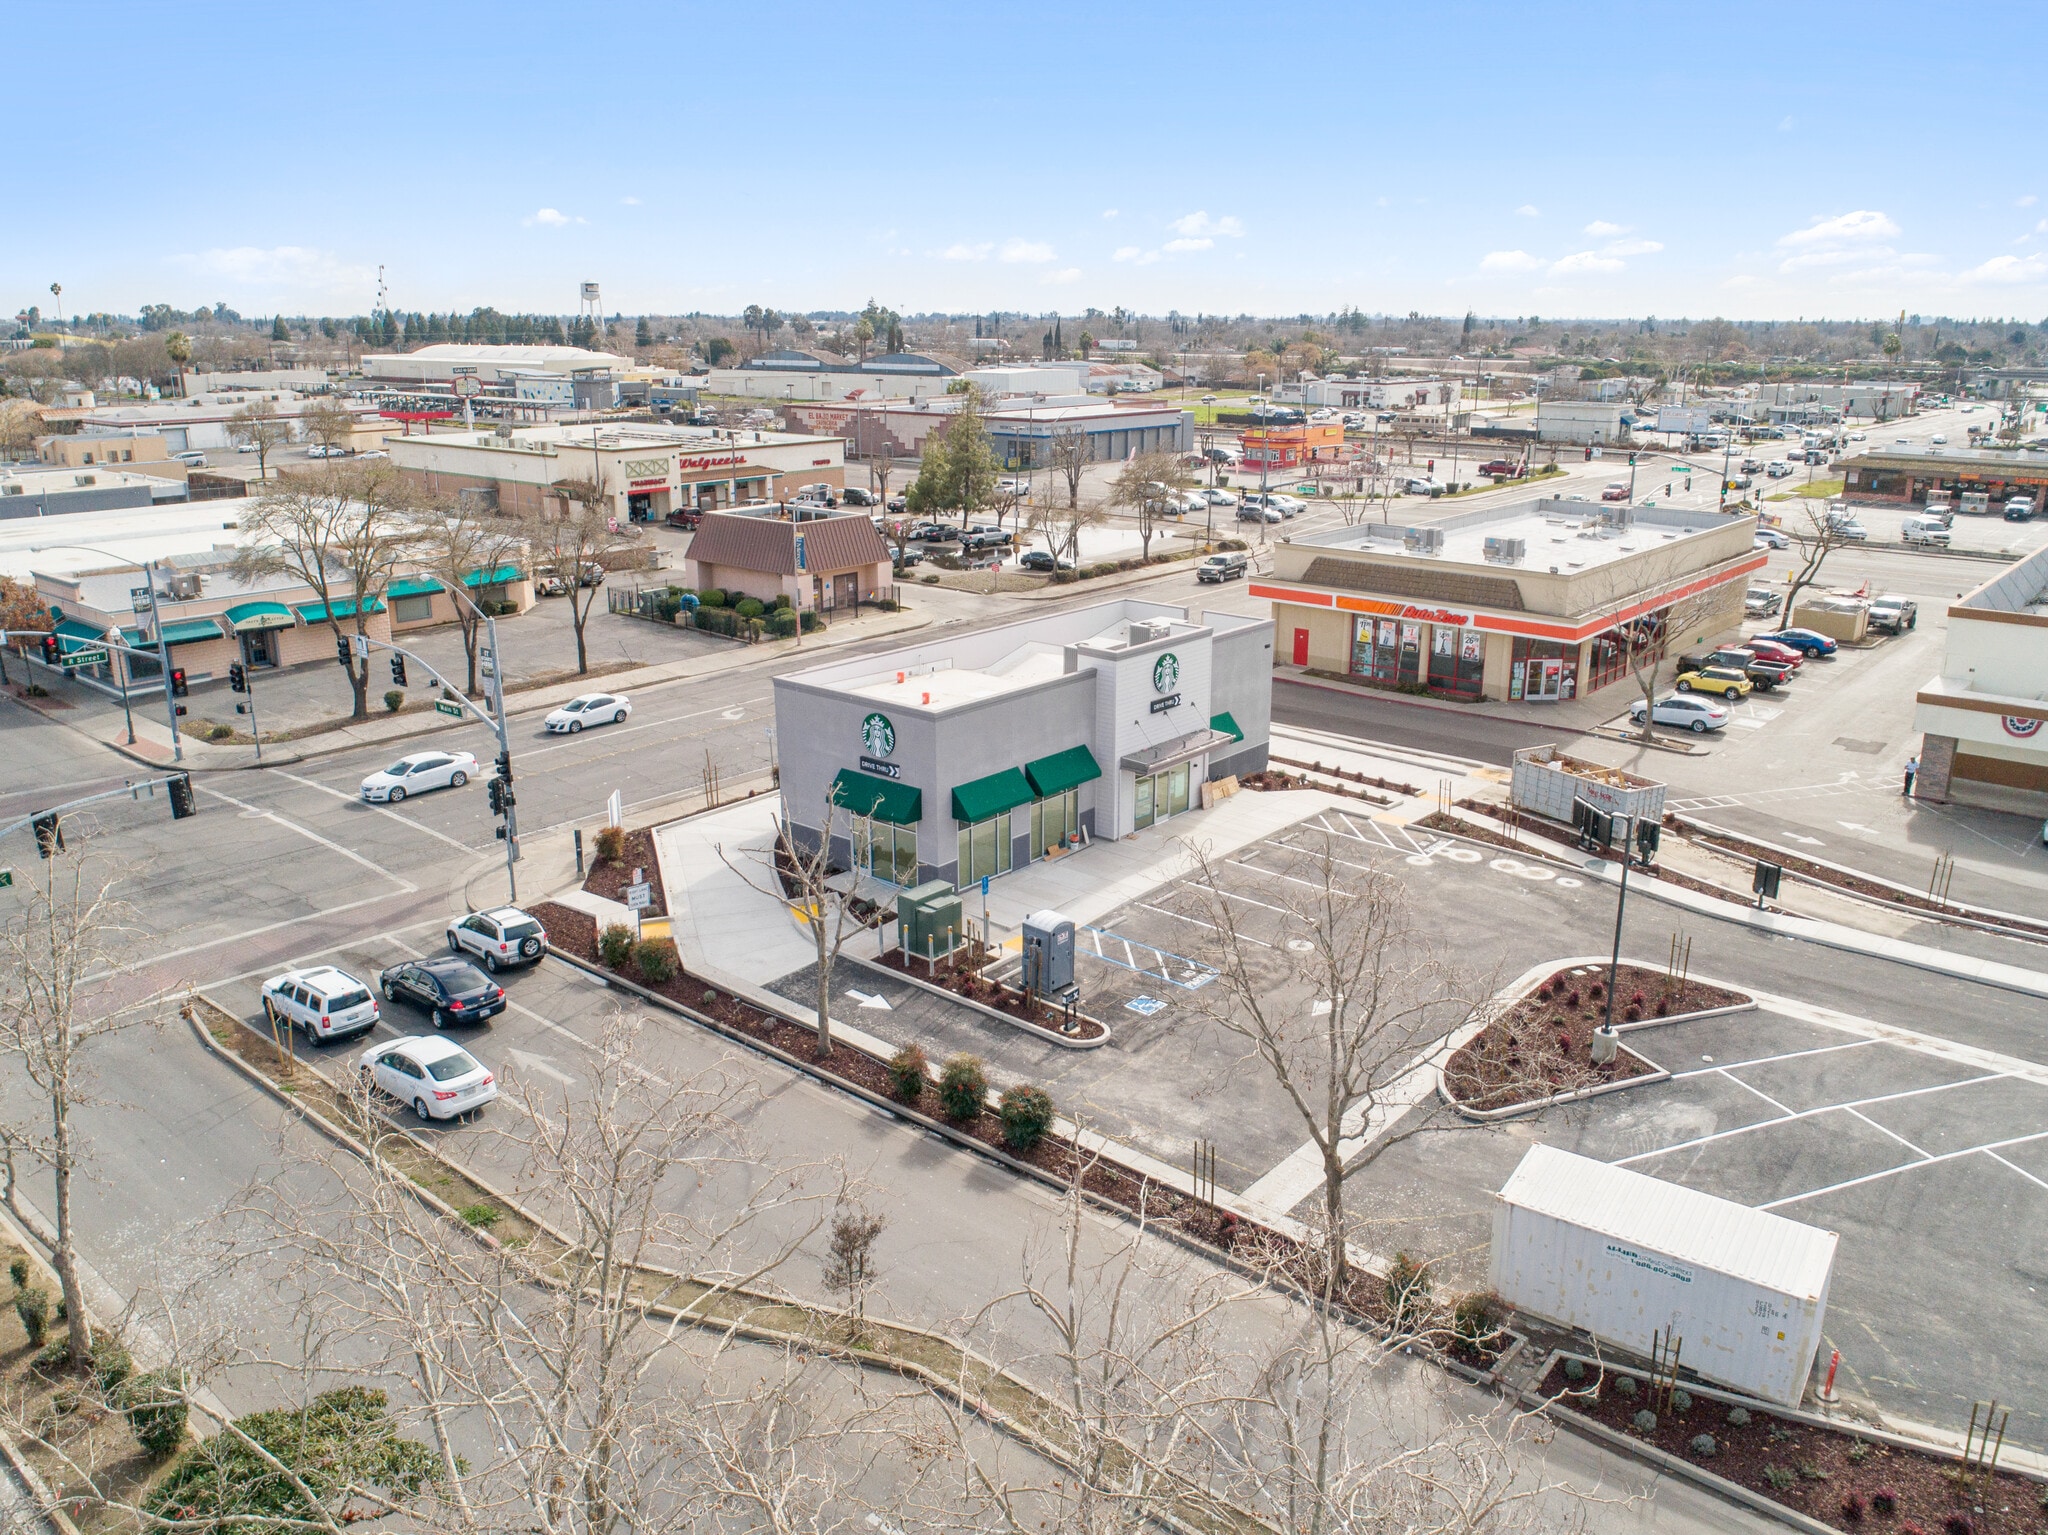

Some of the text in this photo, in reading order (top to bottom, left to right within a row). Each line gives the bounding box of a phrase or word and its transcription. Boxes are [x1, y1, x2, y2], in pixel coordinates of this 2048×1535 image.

[808, 412, 814, 420] EL
[830, 413, 849, 421] MARKET
[680, 456, 747, 470] Walgreens
[630, 478, 667, 487] PHARMACY
[1402, 606, 1468, 625] AutoZone
[77, 654, 100, 663] Street
[440, 704, 459, 715] Main St
[861, 761, 889, 773] DRIVE THRU
[631, 893, 645, 901] MUST
